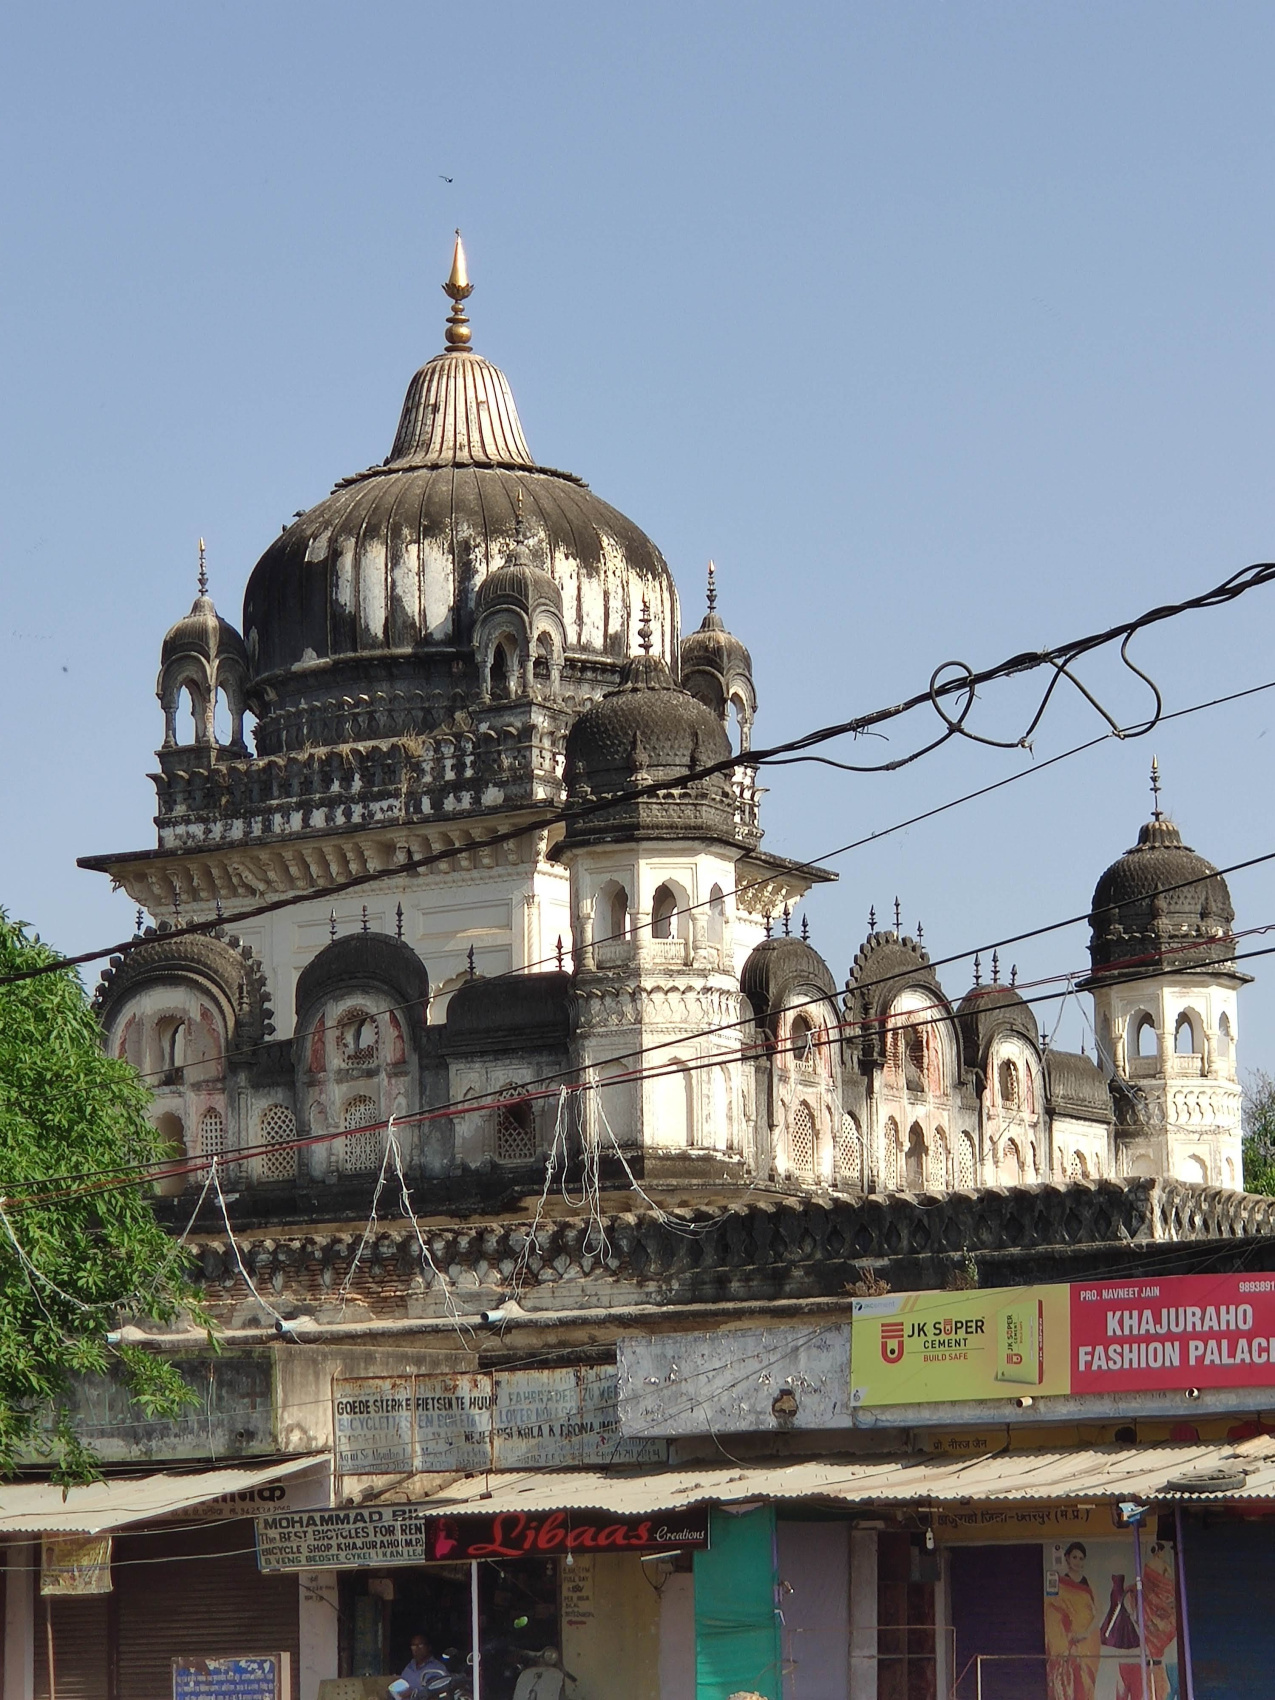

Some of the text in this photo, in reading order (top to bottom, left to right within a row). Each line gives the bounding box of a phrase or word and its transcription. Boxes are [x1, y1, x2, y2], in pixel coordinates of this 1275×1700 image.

[1080, 1286, 1160, 1301] PRO. NAVNEET JAIN
[907, 1318, 985, 1338] JK SUPER
[1106, 1304, 1253, 1336] KHAJURAHO
[923, 1338, 968, 1349] CEMENT
[923, 1352, 968, 1363] BUILD SAFE
[1078, 1341, 1180, 1371] FASHION
[337, 1399, 371, 1415] GOEDE
[373, 1398, 412, 1414] STERKE
[455, 1396, 465, 1411] TE
[263, 1510, 383, 1530] MOHAMMAD
[260, 1533, 277, 1545] The
[279, 1529, 308, 1543] BEST
[312, 1526, 369, 1541] BICYCLES
[374, 1525, 396, 1537] FOR
[467, 1511, 705, 1557] Libaas Creations
[261, 1544, 303, 1556] BICYCLE
[306, 1543, 333, 1554] SHOP
[306, 1553, 344, 1563] BEDSTE
[345, 1551, 372, 1561] CYKEL
[382, 1550, 404, 1559] KAN
